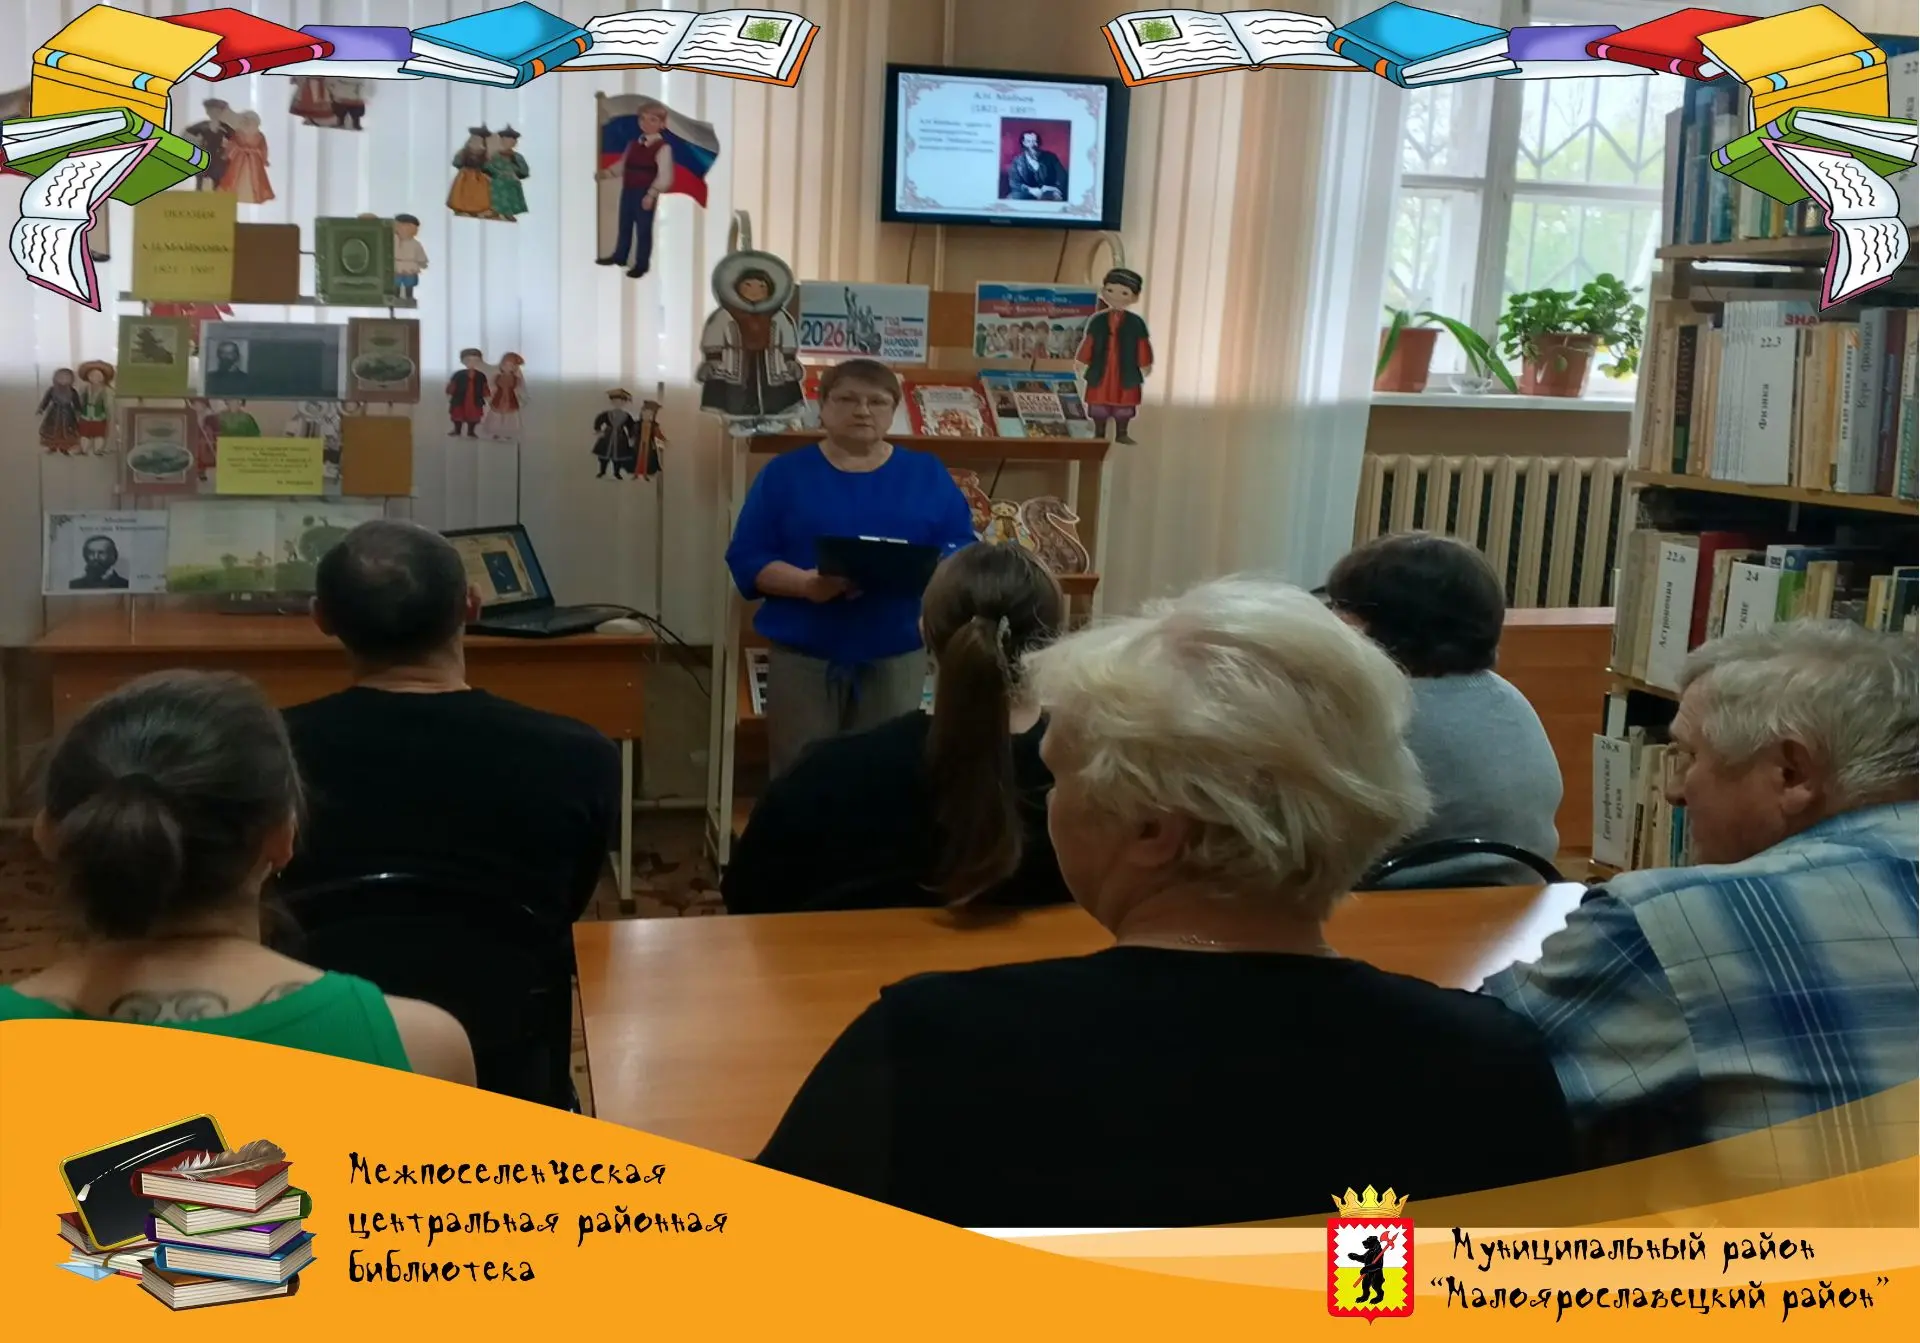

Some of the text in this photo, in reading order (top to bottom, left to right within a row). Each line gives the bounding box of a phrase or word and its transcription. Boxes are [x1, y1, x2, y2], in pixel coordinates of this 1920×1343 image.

[800, 320, 847, 348] 2026
[1758, 384, 1770, 430] Физика
[1745, 569, 1759, 581] 24
[1659, 581, 1674, 649] Астрономия
